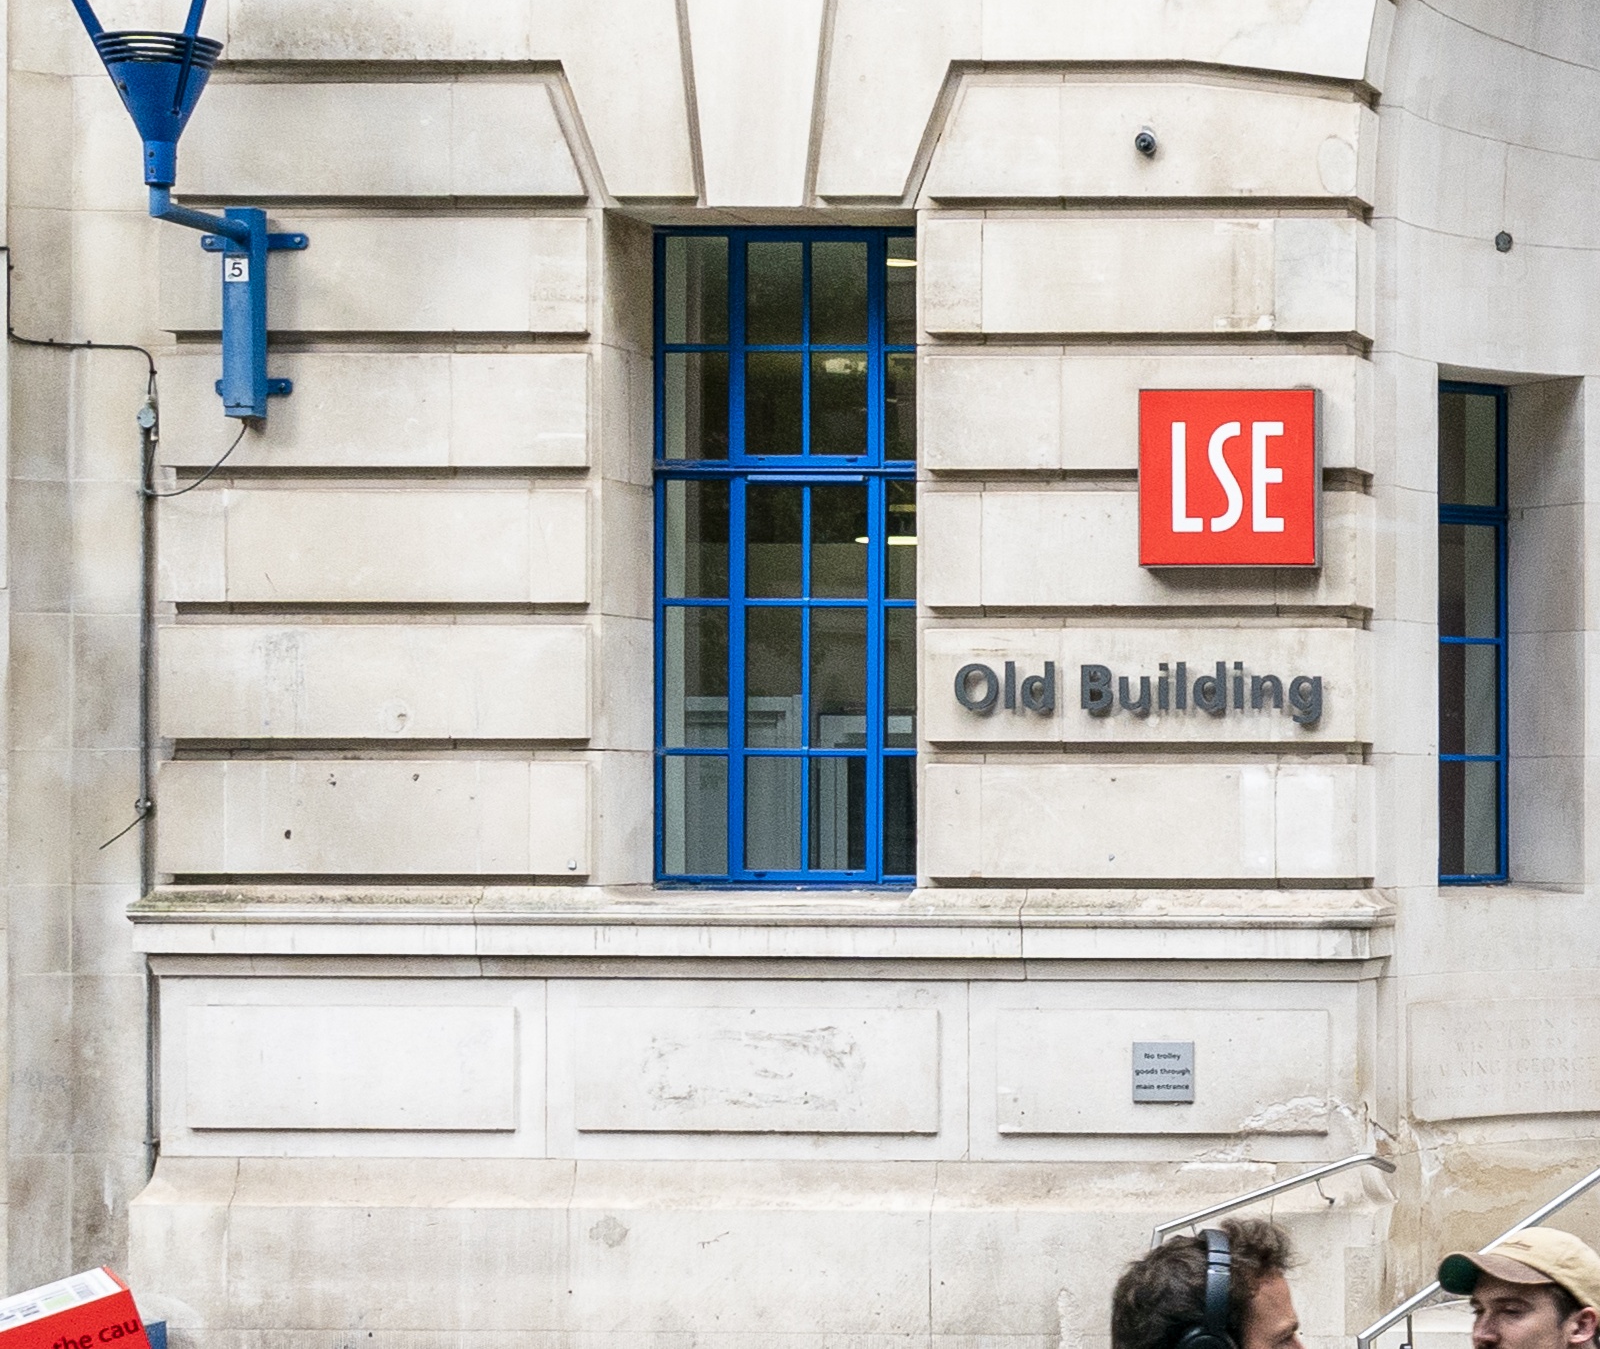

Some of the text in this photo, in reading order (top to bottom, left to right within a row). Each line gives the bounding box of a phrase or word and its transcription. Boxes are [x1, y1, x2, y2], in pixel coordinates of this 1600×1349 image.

[230, 261, 243, 278] 5
[1171, 421, 1285, 533] LSE
[954, 660, 1324, 725] Old Building
[1143, 1052, 1181, 1061] No trolley
[1134, 1067, 1191, 1076] goods through
[1135, 1083, 1190, 1091] main entrance
